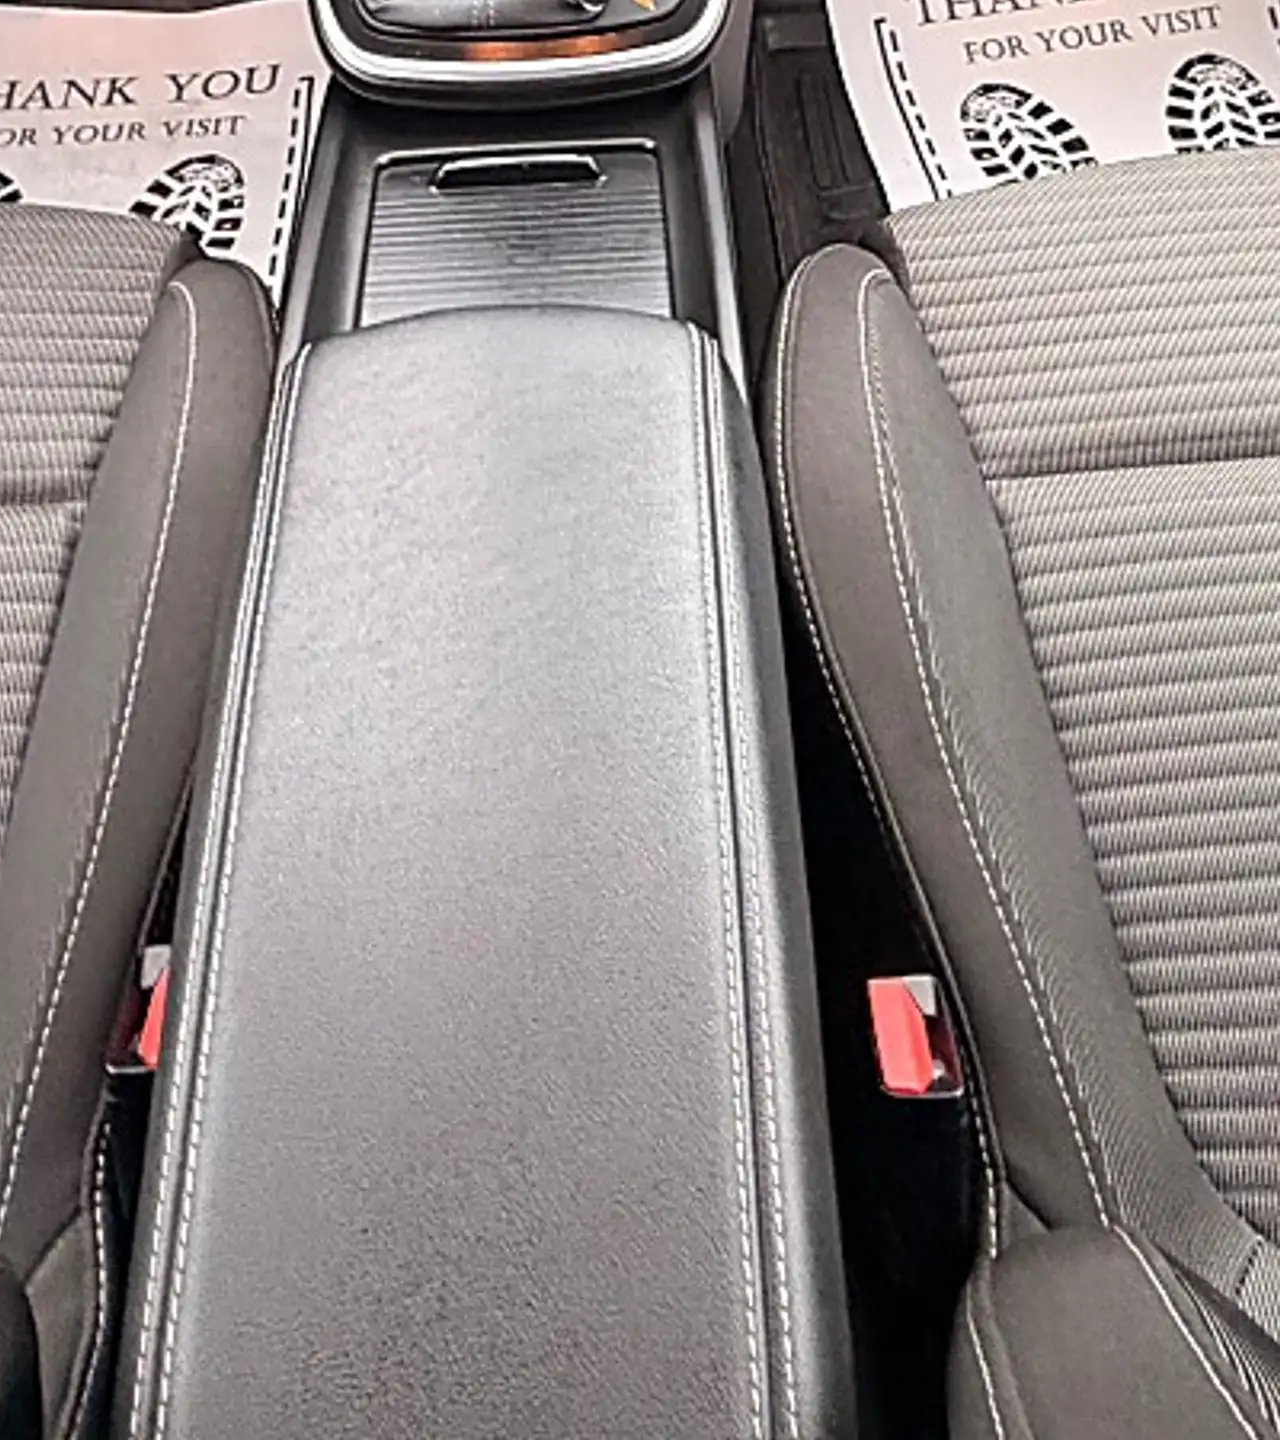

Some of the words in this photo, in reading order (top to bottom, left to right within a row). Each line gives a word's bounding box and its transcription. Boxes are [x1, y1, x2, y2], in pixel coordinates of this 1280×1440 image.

[964, 35, 1028, 64] FOR
[1035, 22, 1133, 57] YOUR
[1141, 5, 1221, 37] VISIT
[165, 63, 281, 103] YOU
[52, 122, 148, 145] YOUR
[163, 115, 245, 139] VISIT
